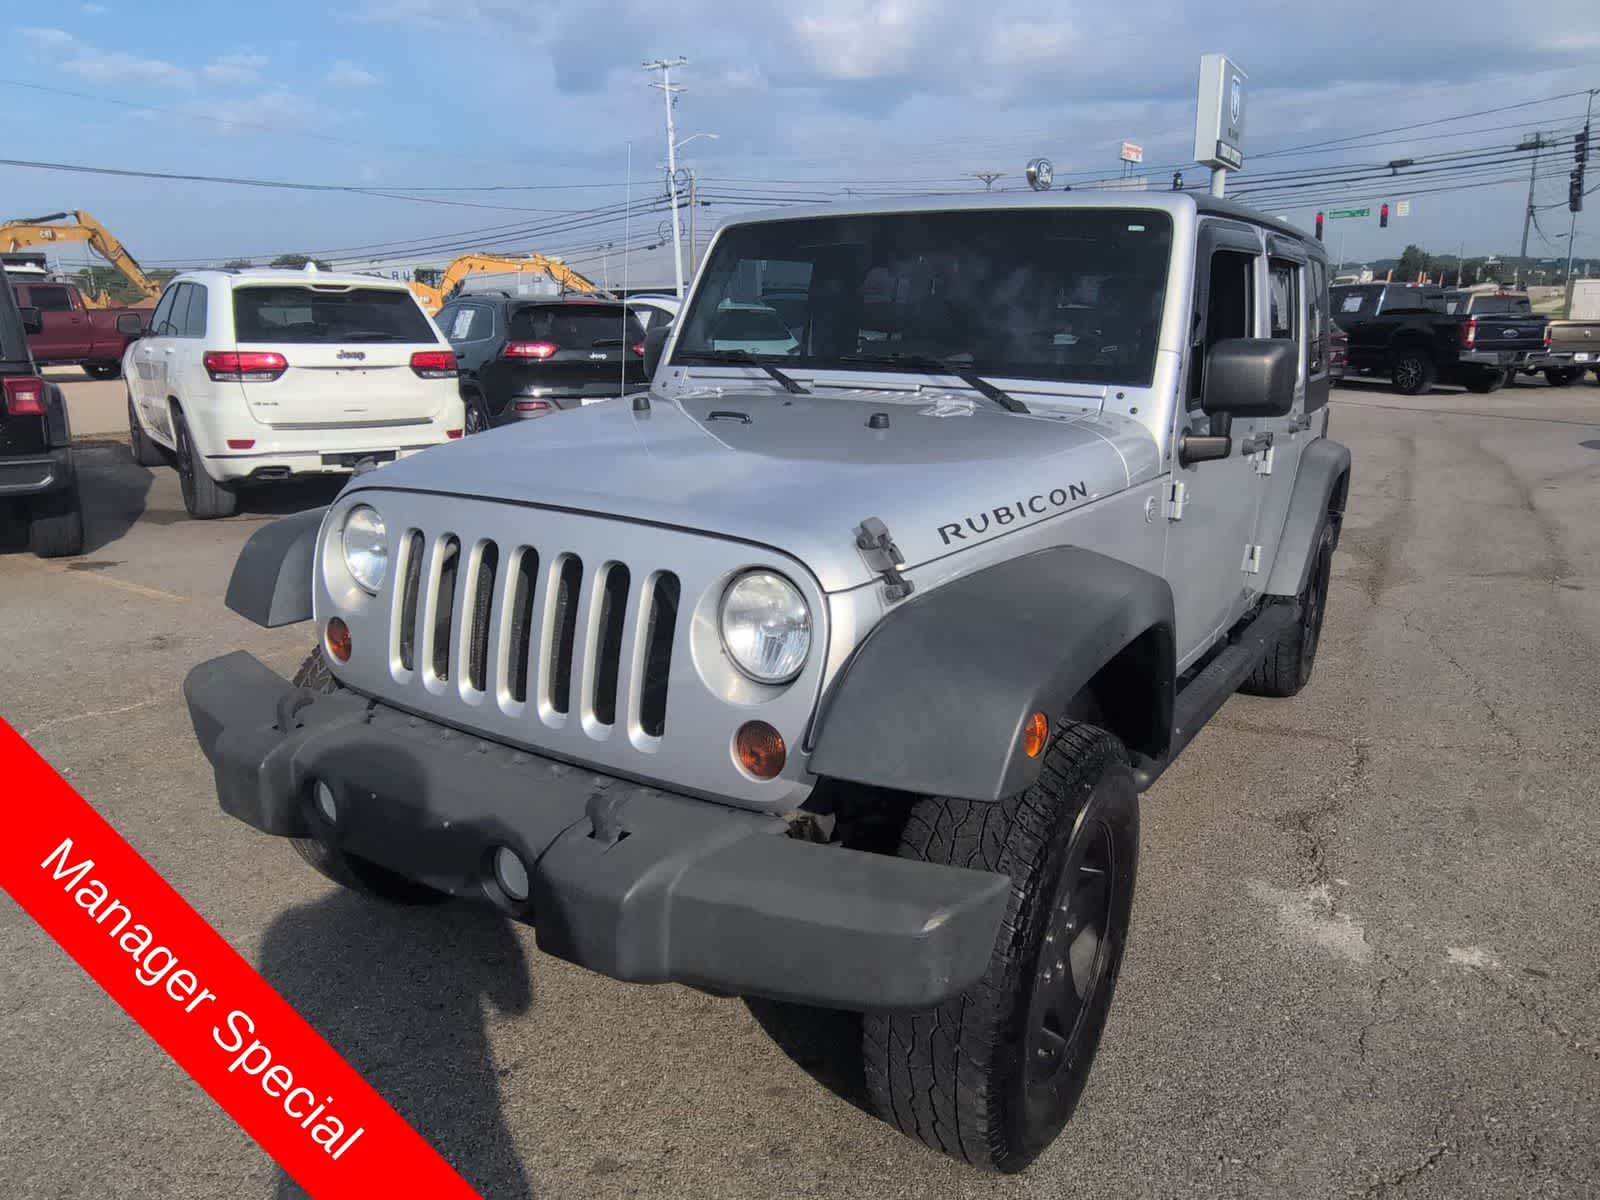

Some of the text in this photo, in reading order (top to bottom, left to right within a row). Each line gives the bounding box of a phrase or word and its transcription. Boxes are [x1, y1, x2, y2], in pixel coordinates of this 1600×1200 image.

[336, 349, 366, 361] Jeep
[589, 351, 607, 360] Jeep
[937, 480, 1088, 545] RUBICON
